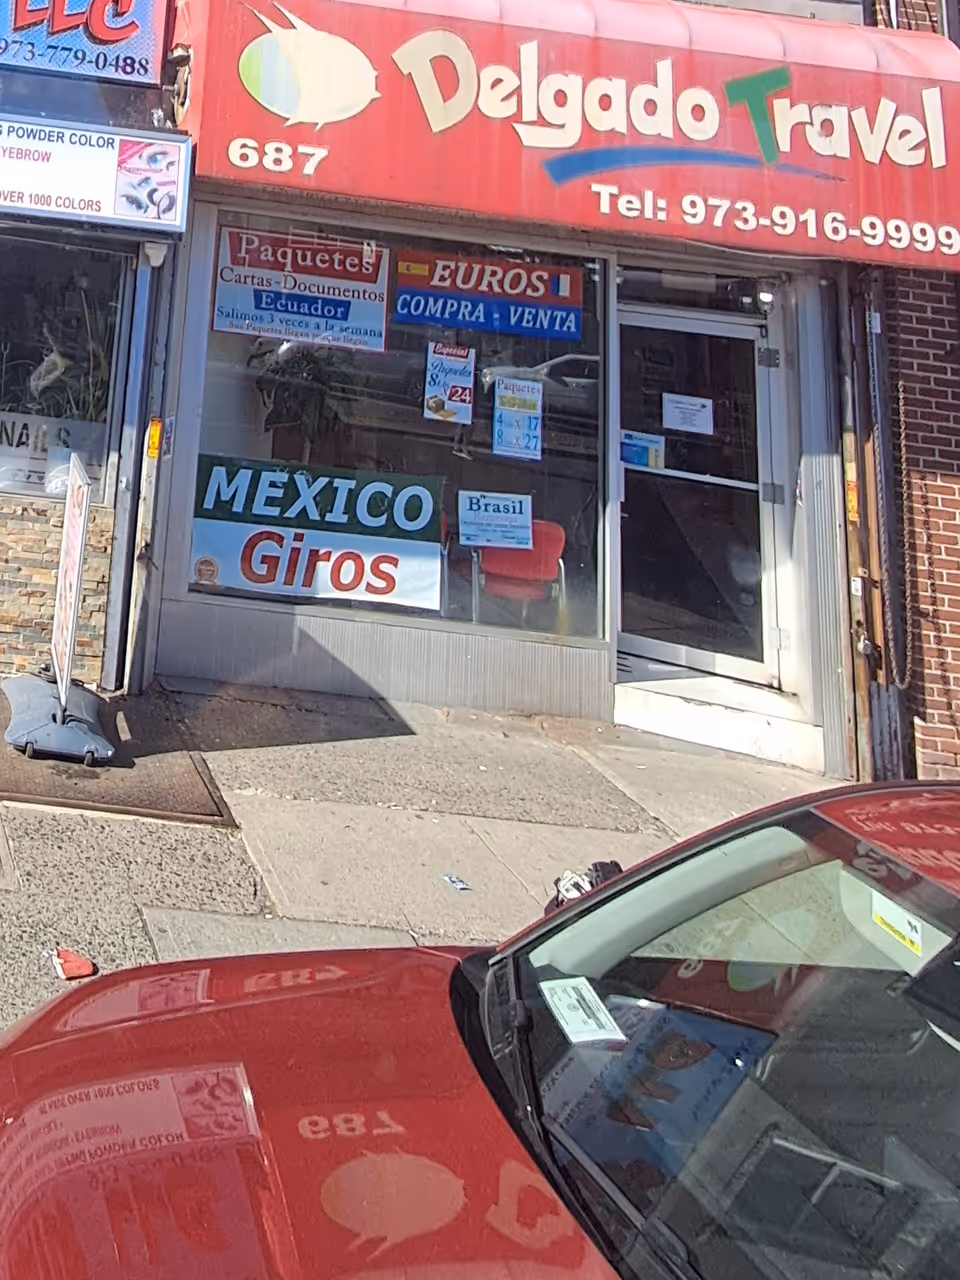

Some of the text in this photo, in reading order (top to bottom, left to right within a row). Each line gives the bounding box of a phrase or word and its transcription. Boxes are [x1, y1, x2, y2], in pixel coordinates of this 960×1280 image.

[391, 28, 947, 169] Delgado Travel
[7, 125, 65, 144] POWDER
[69, 132, 115, 150] COLOR
[227, 137, 329, 176] 687
[28, 193, 52, 207] 1000
[55, 196, 102, 212] COLORS
[590, 183, 960, 256] Tel: 973-916-9999
[237, 233, 374, 273] Paquetes
[430, 259, 549, 297] EUROS
[259, 292, 345, 317] Ecuador
[397, 294, 577, 332] COMPRA VENTA
[451, 387, 471, 402] 24
[203, 466, 434, 532] MEXICO
[467, 496, 524, 515] Brasil
[240, 529, 399, 596] Giros
